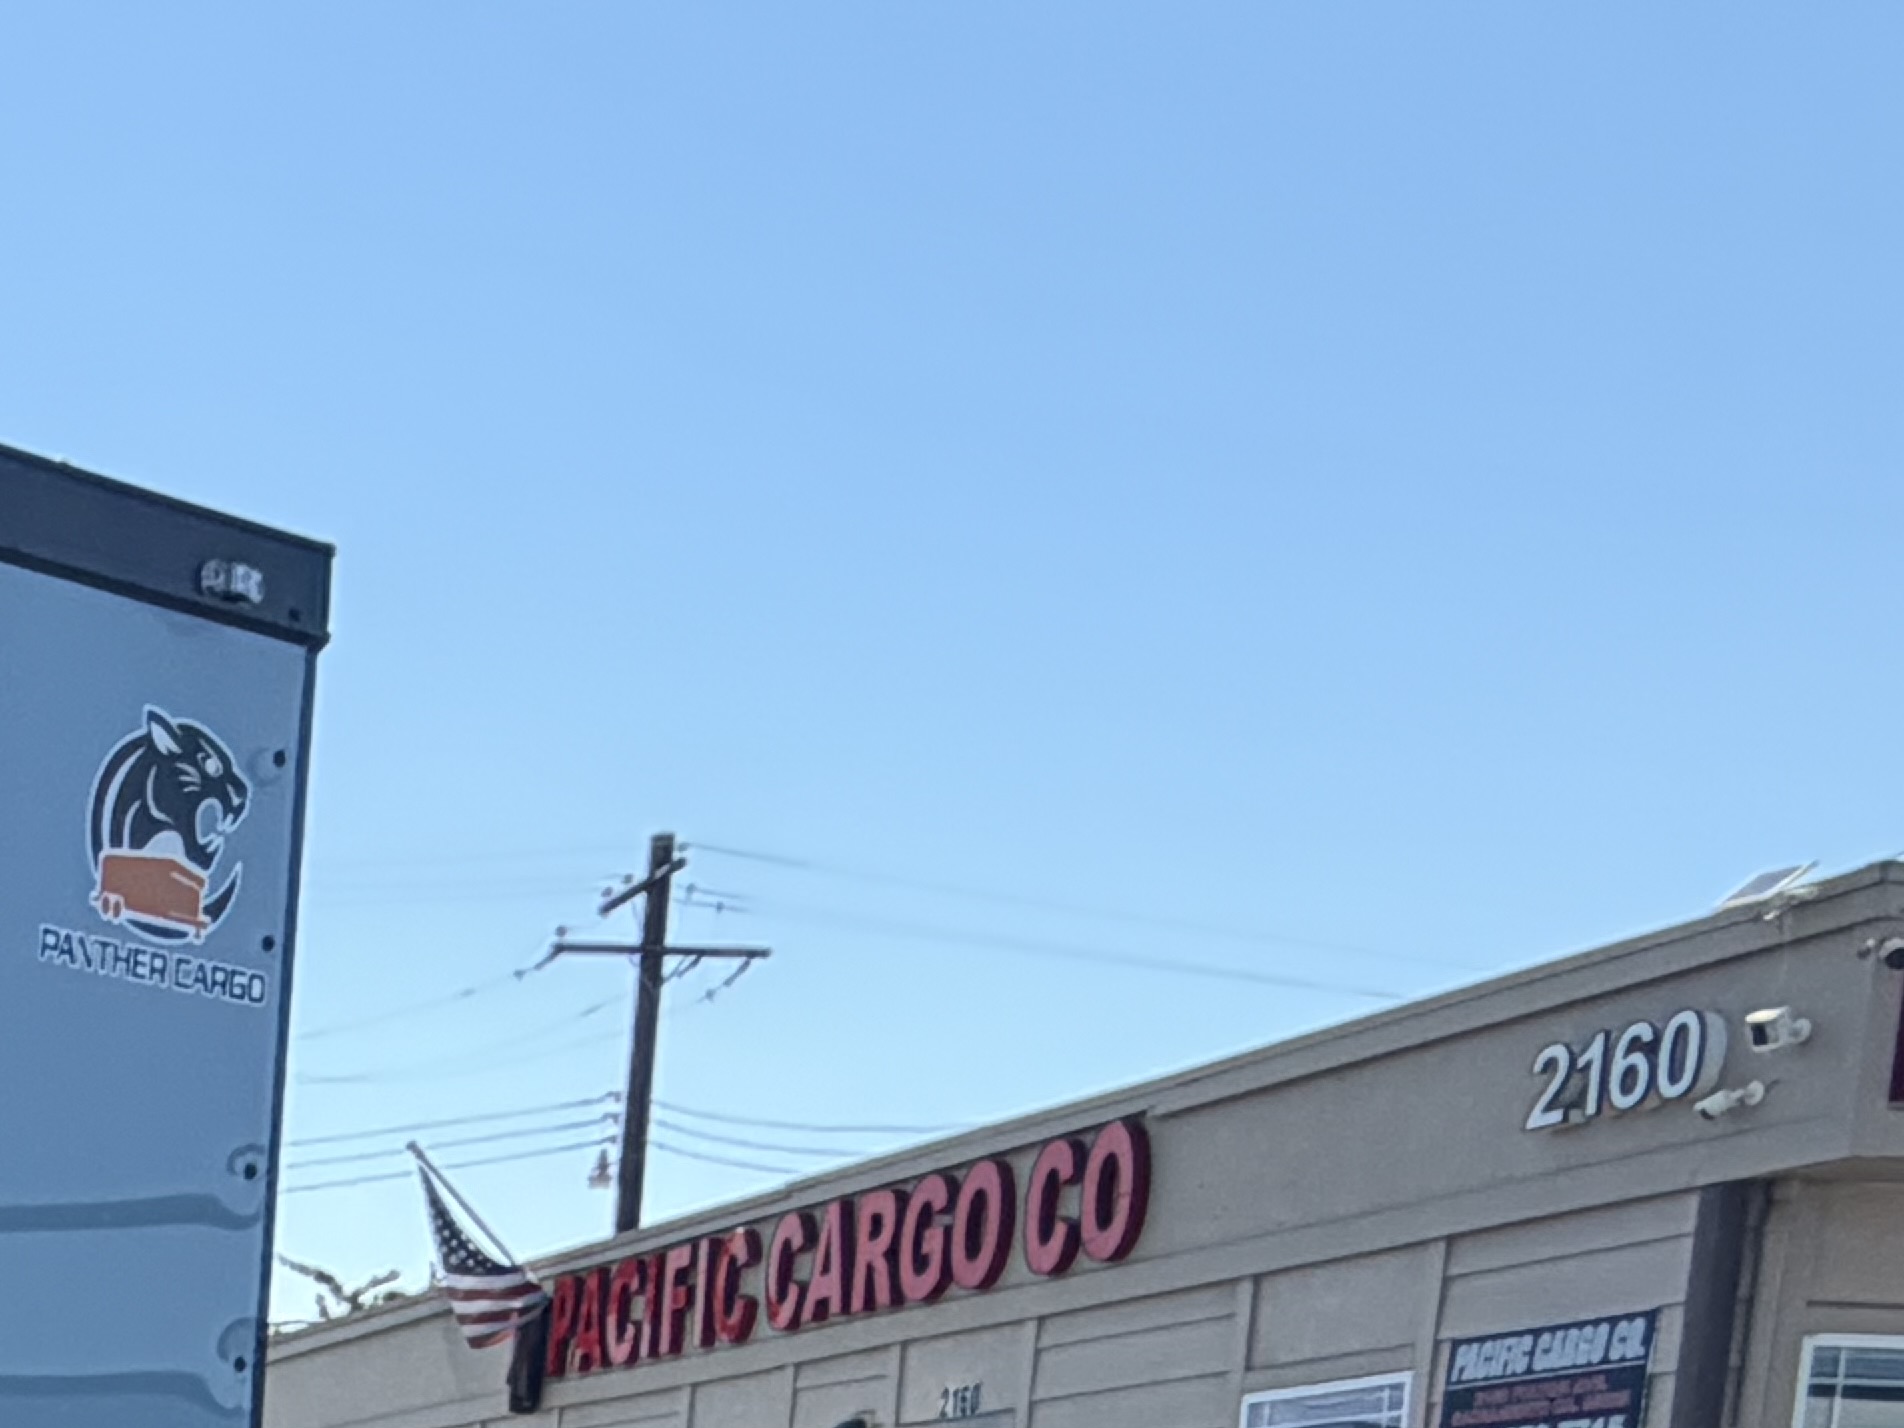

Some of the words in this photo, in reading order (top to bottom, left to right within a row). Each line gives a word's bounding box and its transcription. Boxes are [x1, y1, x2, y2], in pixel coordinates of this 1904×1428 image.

[39, 925, 168, 986] PANTHER
[174, 957, 267, 1005] CARGO
[1525, 1010, 1703, 1130] 2160
[546, 1225, 763, 1378] PACIFIC
[767, 1157, 1016, 1332] CARGO
[1025, 1118, 1150, 1276] CO
